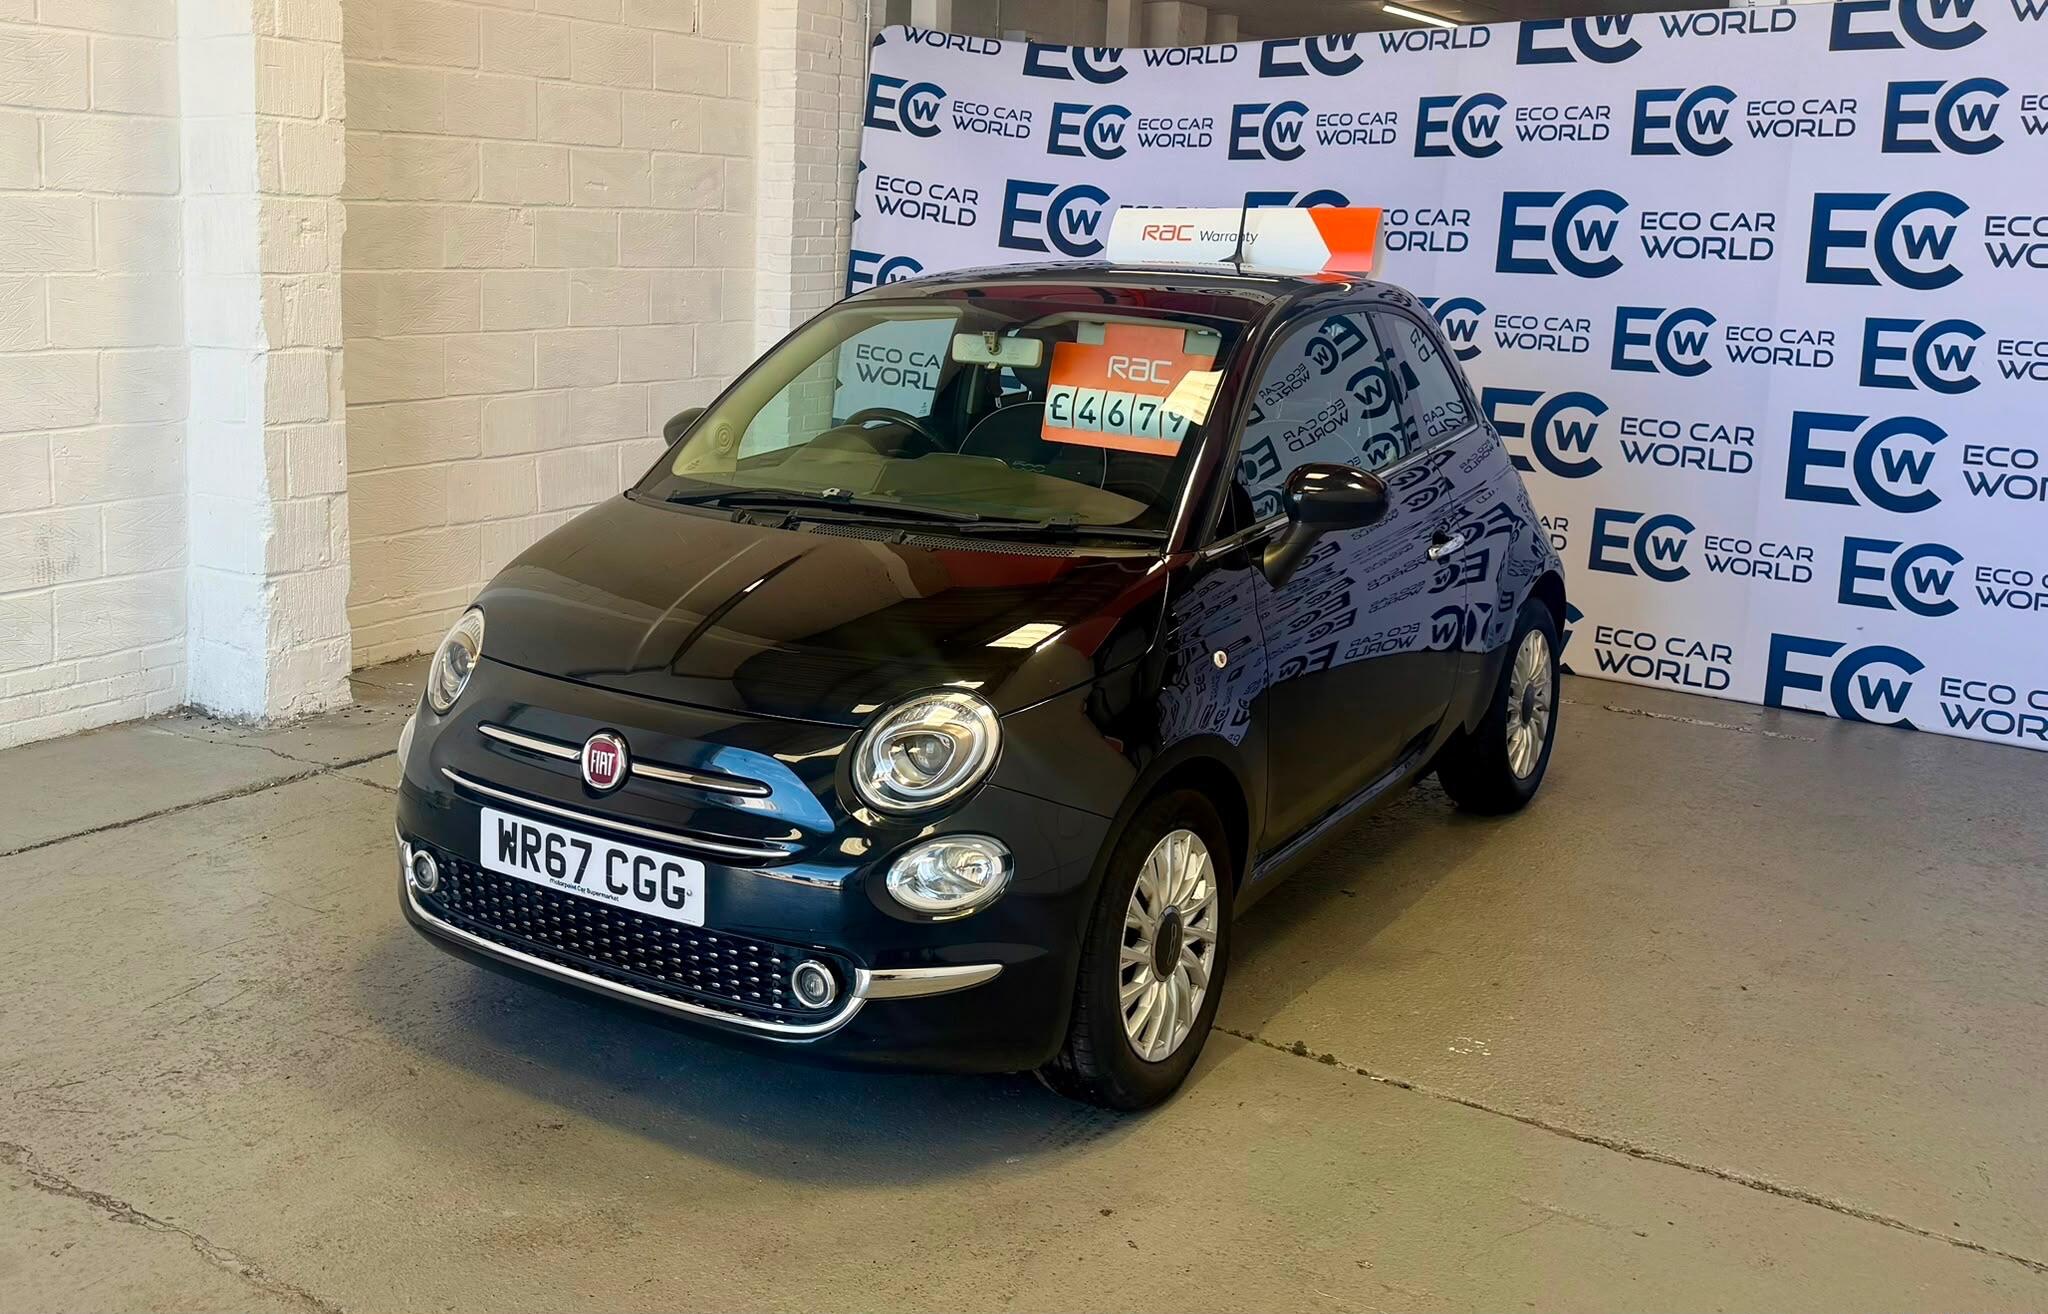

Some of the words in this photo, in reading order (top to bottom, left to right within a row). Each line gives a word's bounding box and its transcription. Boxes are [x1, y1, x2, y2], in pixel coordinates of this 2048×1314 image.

[1659, 8, 1797, 38] WORLD
[902, 26, 1002, 55] WORLD
[1379, 26, 1490, 54] WORLD
[1143, 44, 1238, 68] WORLD
[952, 100, 989, 117] ECO
[995, 106, 1032, 123] CAR
[1316, 114, 1354, 127] ECO
[1358, 111, 1398, 126] CAR
[1516, 106, 1558, 121] ECO
[1564, 105, 1611, 120] CAR
[1746, 100, 1796, 116] ECO
[1802, 98, 1857, 115] CAR
[952, 114, 1031, 139] WORLD
[1138, 118, 1172, 130] ECO
[1177, 118, 1214, 130] CAR
[1516, 123, 1610, 142] WORLD
[1746, 118, 1856, 138] WORLD
[1138, 132, 1212, 148] WORLD
[1316, 127, 1397, 146] WORLD
[875, 175, 922, 196] ECO
[928, 184, 978, 206] CAR
[874, 194, 976, 227] WORLD
[1416, 209, 1471, 226] CAR
[1640, 212, 1700, 230] ECO
[1710, 212, 1776, 232] CAR
[1384, 231, 1468, 252] ORLD
[1640, 235, 1774, 262] WORLD
[1494, 314, 1538, 330] ECO
[1544, 318, 1591, 333] CAR
[1494, 332, 1590, 354] WORLD
[1726, 326, 1772, 342] ECO
[1780, 330, 1835, 346] CAR
[856, 344, 902, 364] ECO
[909, 352, 940, 369] CA
[1726, 345, 1834, 368] WORLD
[856, 363, 936, 391] WORL
[1620, 416, 1681, 440] ECO
[1690, 422, 1755, 446] CAR
[1620, 440, 1752, 474] WORLD
[1963, 444, 2039, 469] ECO
[1541, 516, 1568, 532] AR
[1704, 536, 1752, 555] ECO
[1759, 542, 1814, 562] CAR
[1704, 554, 1813, 584] WORLD
[1976, 566, 2034, 586] ECO
[1595, 626, 1656, 651] ECO
[1665, 638, 1732, 664] CAR
[1594, 648, 1730, 691] WORLD
[1940, 676, 2016, 705] ECO
[590, 750, 616, 776] FIAT
[498, 818, 592, 884] WR67
[606, 849, 686, 910] CGG
